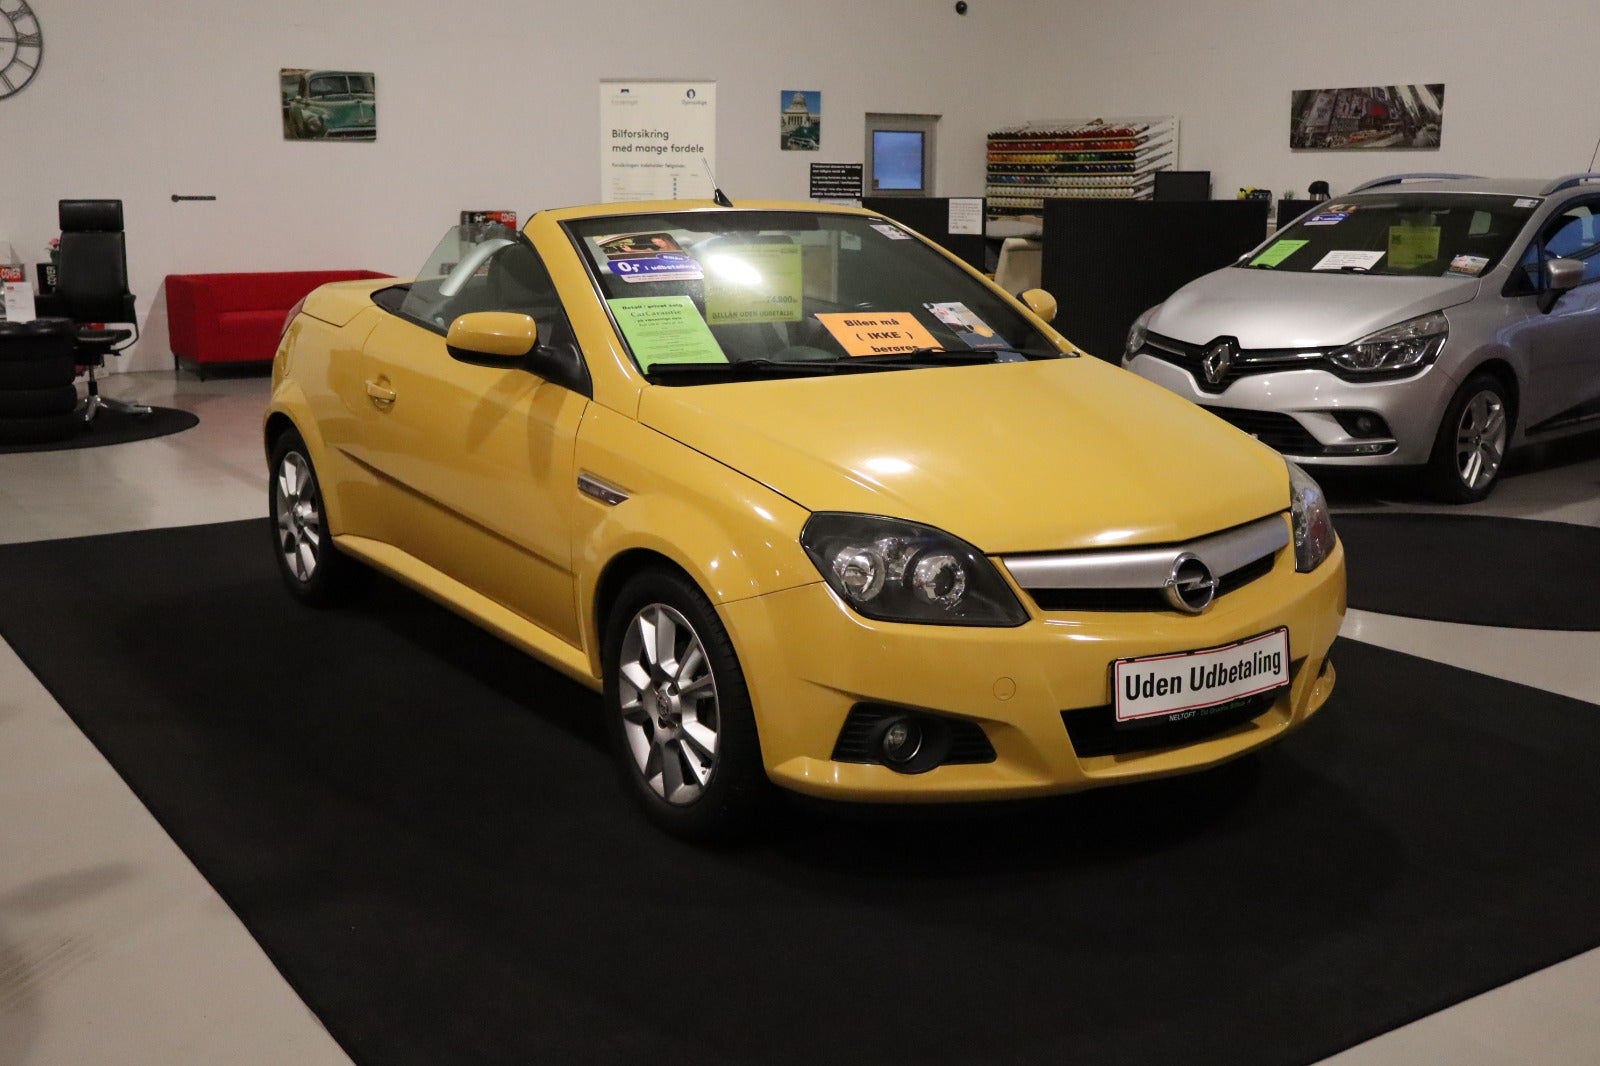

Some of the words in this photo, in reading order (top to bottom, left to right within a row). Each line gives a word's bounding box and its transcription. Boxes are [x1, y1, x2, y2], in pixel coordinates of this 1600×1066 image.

[612, 129, 669, 140] Bilforsikring
[612, 144, 632, 153] med
[635, 146, 668, 155] mange
[671, 144, 704, 153] fordele
[844, 319, 877, 327] Bilen
[880, 318, 900, 326] må
[867, 331, 901, 340] IKKE
[1125, 672, 1182, 701] Uden
[1189, 650, 1282, 692] Udbetaling
[1169, 710, 1197, 721] NELTOFT
